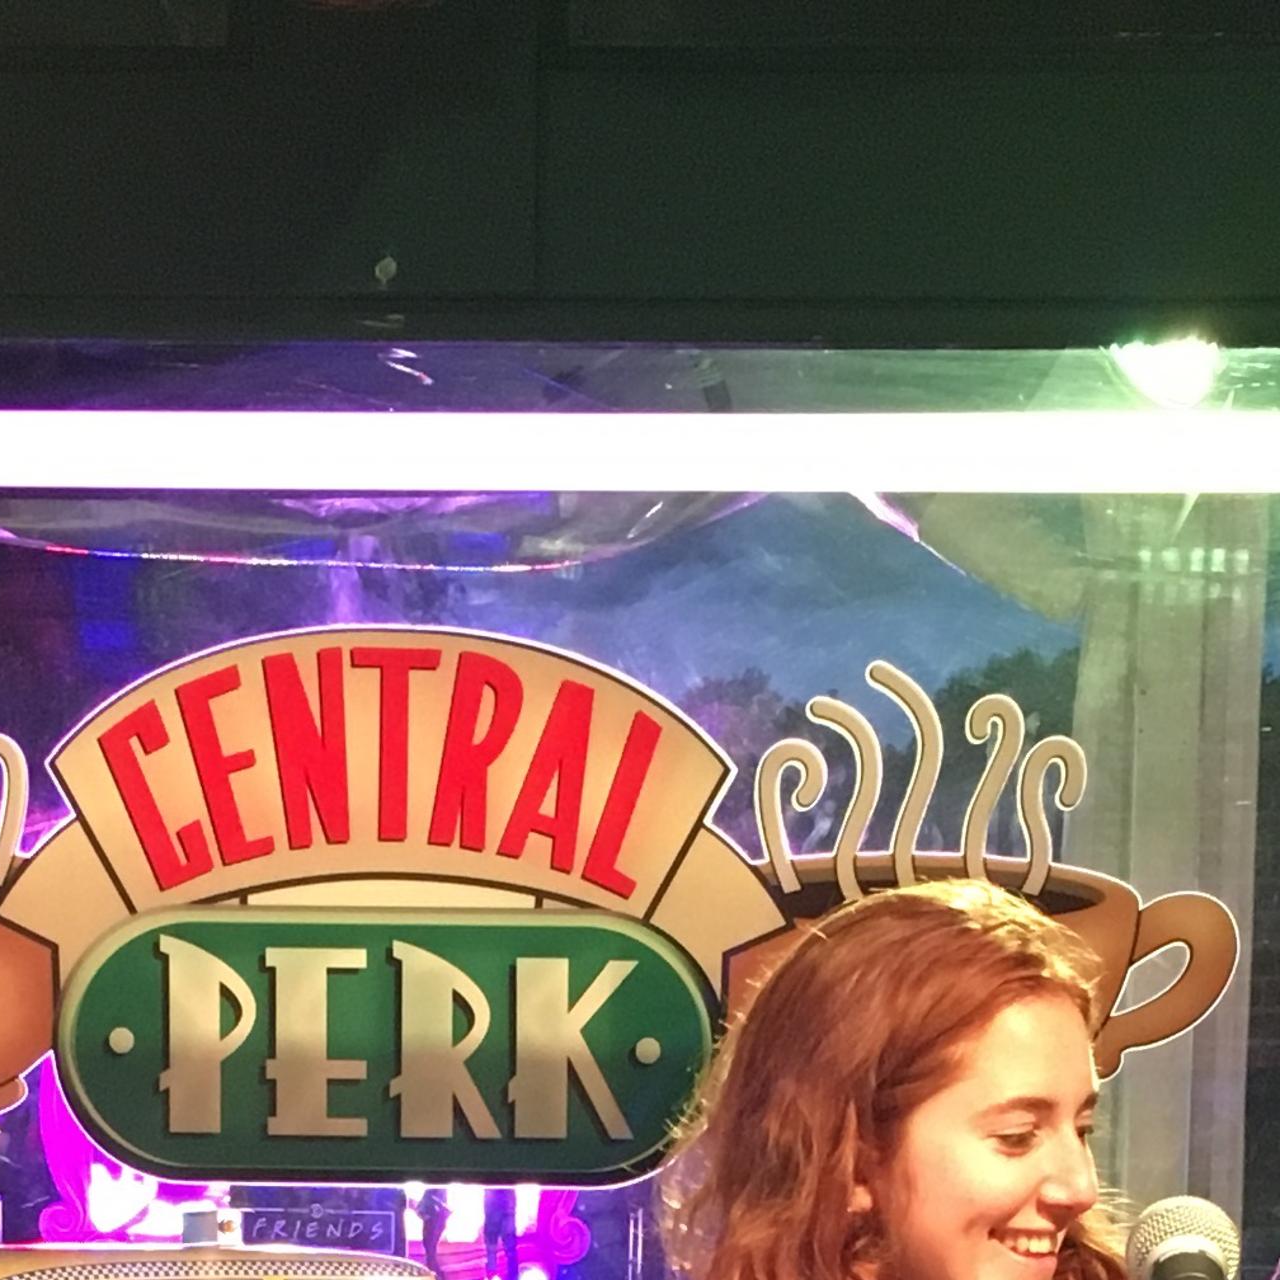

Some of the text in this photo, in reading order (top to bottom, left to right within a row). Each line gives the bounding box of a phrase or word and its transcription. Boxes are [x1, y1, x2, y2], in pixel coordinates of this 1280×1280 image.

[97, 645, 662, 900] CENTRAL
[158, 933, 639, 1141] PERK
[252, 1217, 384, 1241] FRIENDS
